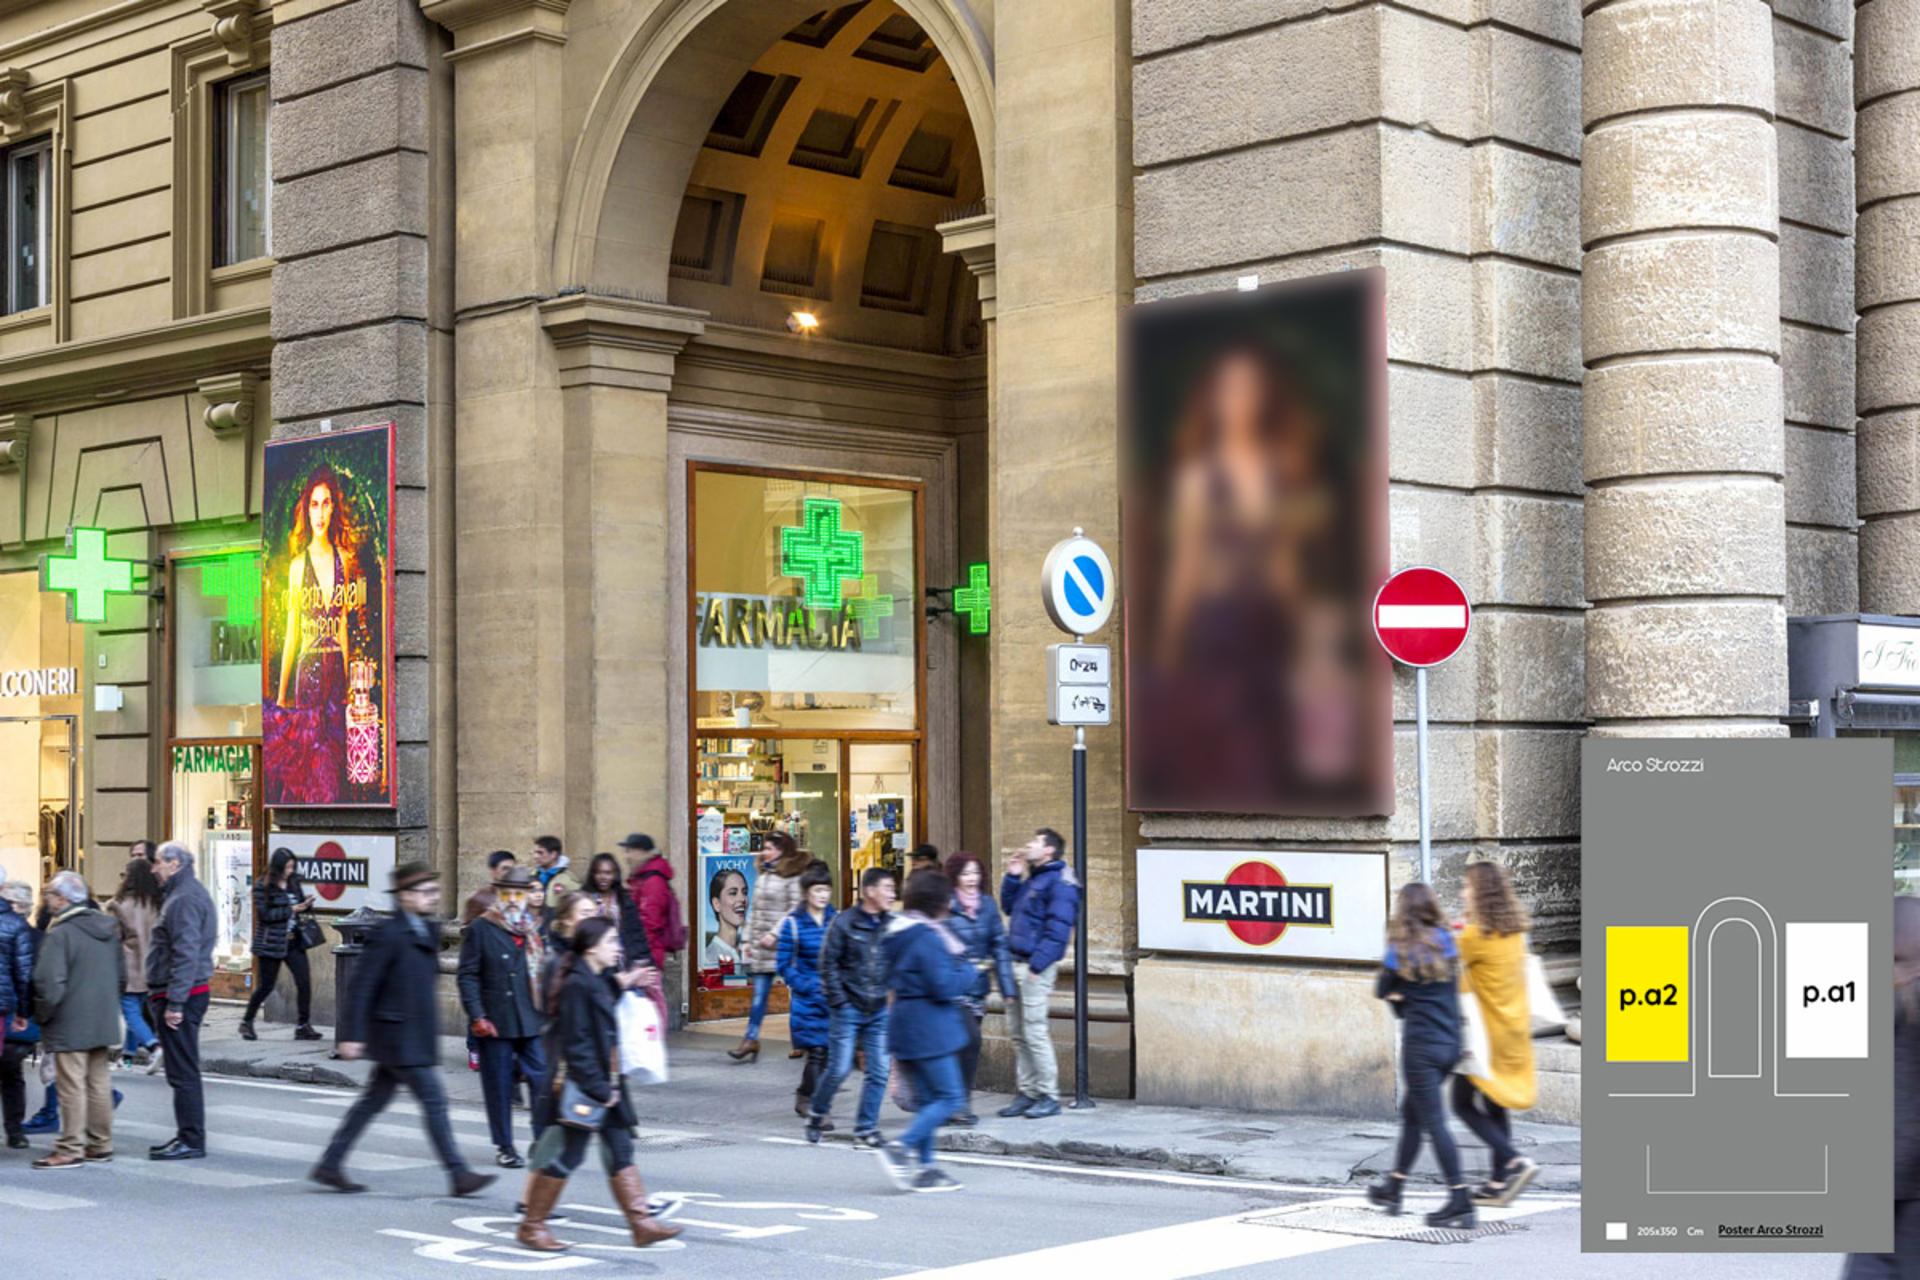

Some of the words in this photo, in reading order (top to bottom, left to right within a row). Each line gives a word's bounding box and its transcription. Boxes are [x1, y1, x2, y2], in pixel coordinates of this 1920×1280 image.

[0, 667, 77, 697] CONERI
[175, 745, 251, 773] FARMACIA
[297, 861, 365, 881] MARTINI
[716, 859, 748, 870] VICHY
[1190, 888, 1324, 919] MARTINI
